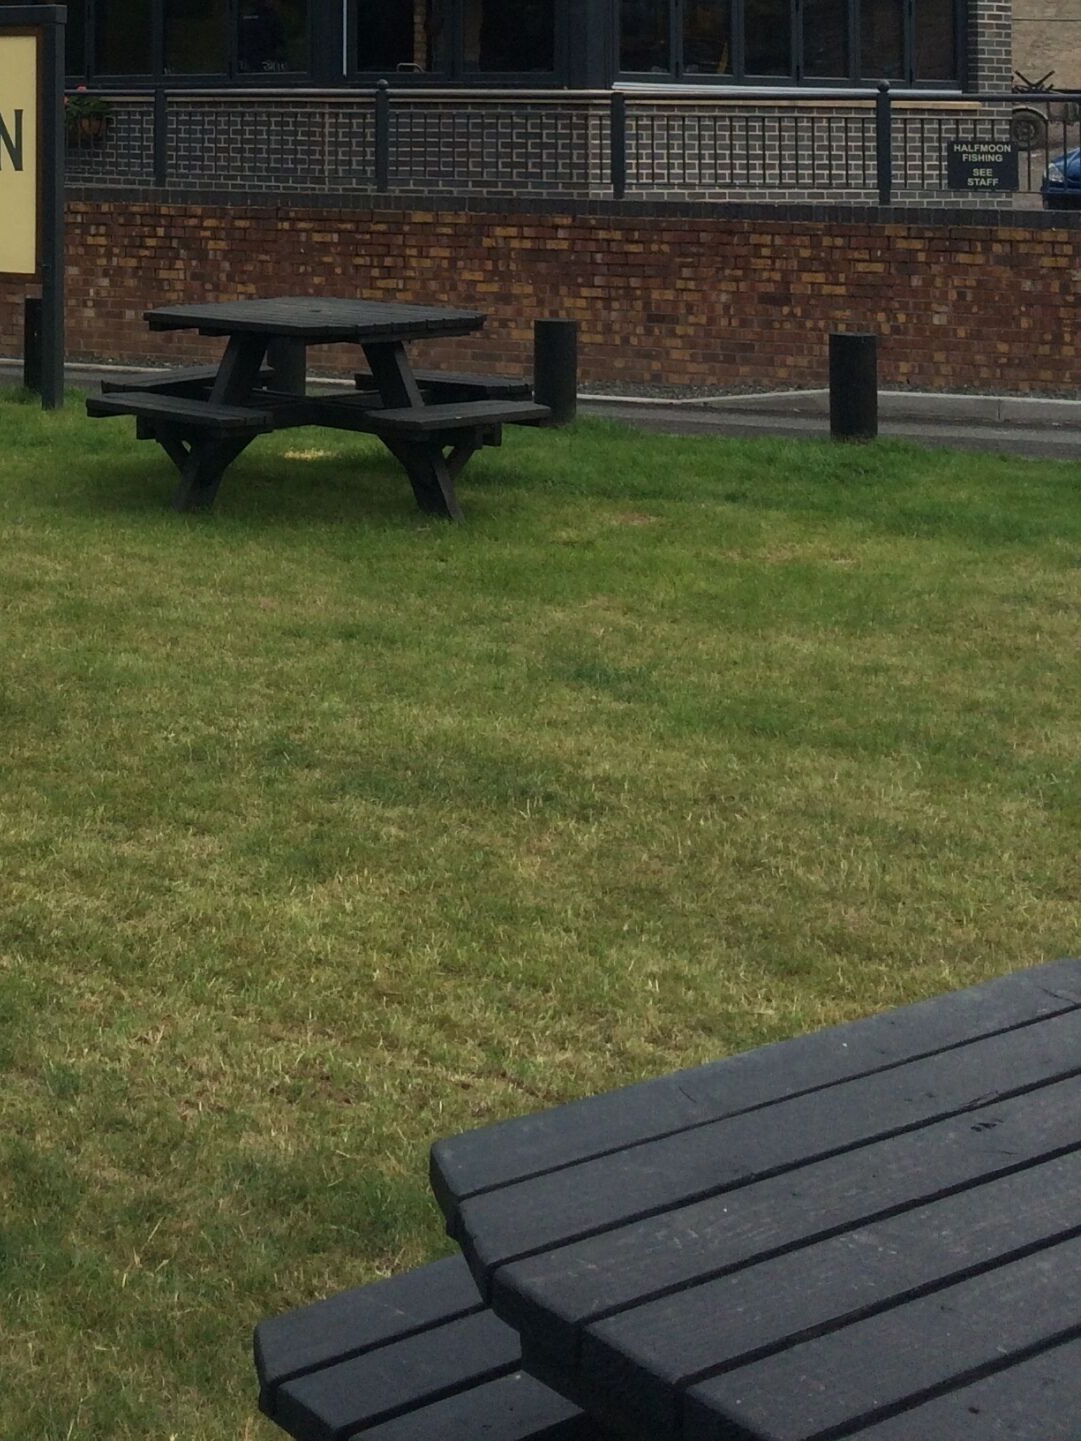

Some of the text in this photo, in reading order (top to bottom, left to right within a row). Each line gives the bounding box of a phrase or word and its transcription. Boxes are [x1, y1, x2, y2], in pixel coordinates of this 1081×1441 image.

[962, 153, 1003, 162] FISHING
[972, 168, 993, 177] SEE
[967, 177, 999, 186] STAFF
